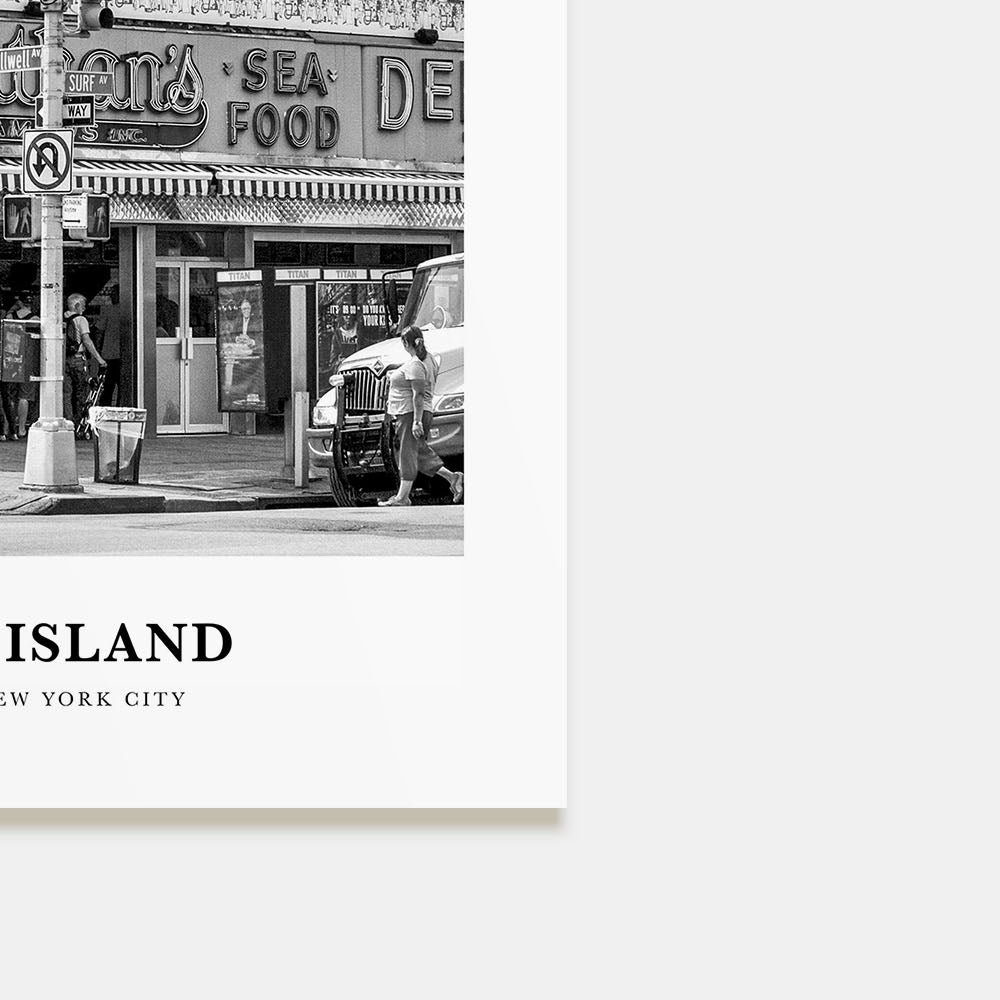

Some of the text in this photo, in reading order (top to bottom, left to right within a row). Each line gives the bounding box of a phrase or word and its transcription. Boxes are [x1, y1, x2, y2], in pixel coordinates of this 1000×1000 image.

[241, 47, 329, 97] SEA
[68, 74, 109, 92] SURF AV
[67, 105, 87, 117] WAY
[226, 101, 340, 150] FOOD
[228, 271, 251, 280] TITAN
[287, 270, 309, 279] TITAN
[335, 270, 357, 279] TITAN
[5, 622, 233, 663] ISLAND
[41, 691, 112, 707] YORK
[124, 691, 186, 707] CITY
